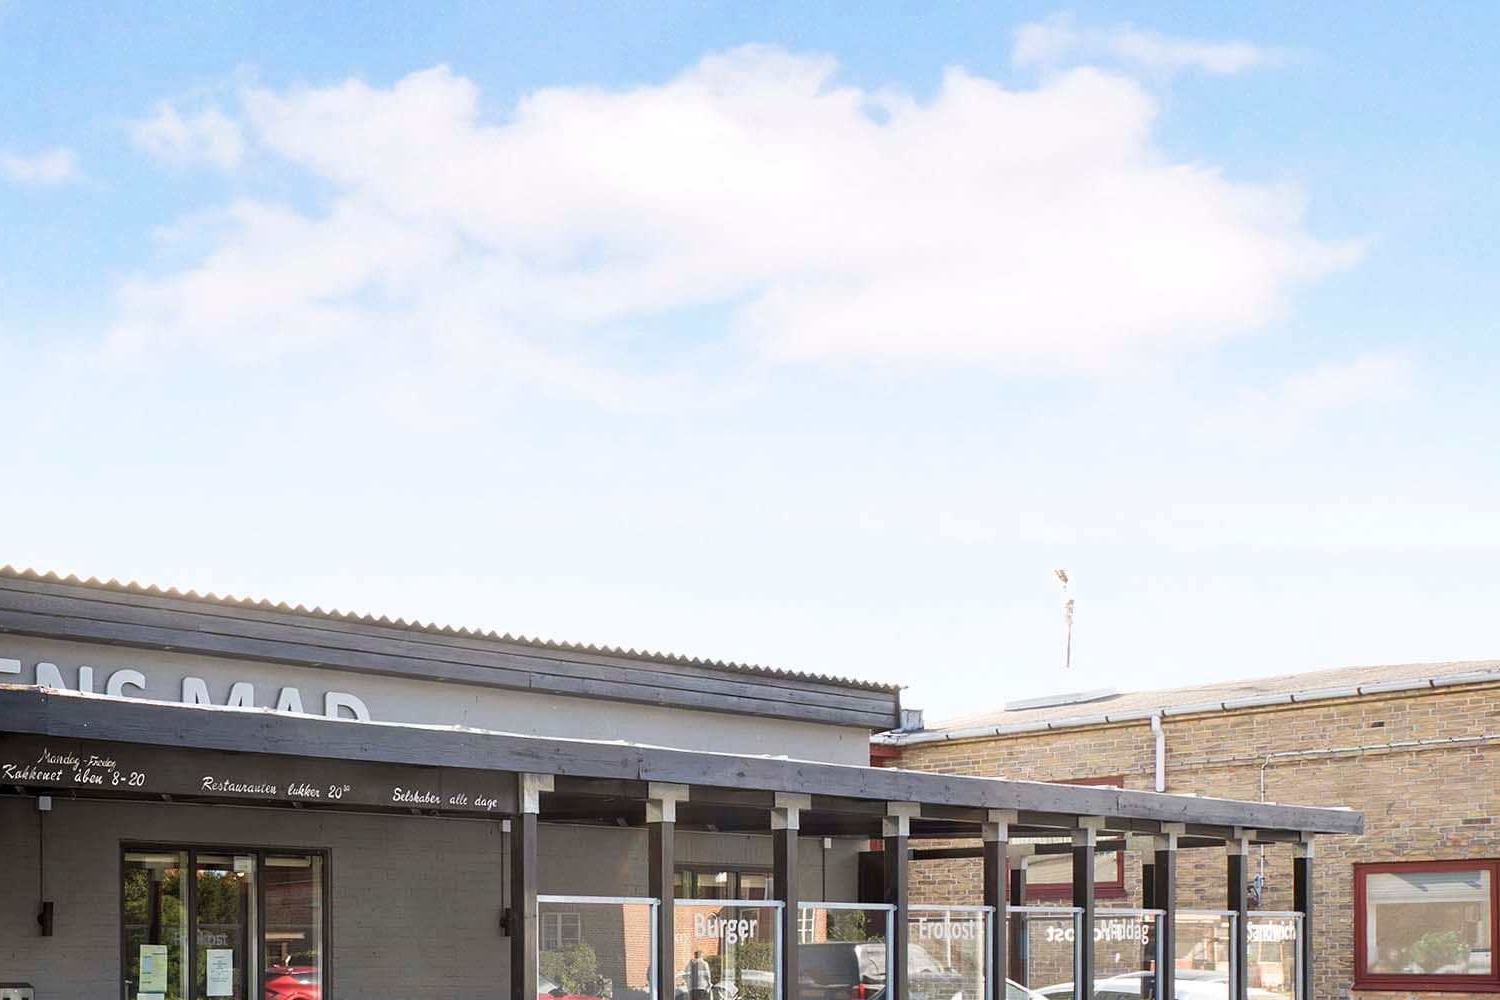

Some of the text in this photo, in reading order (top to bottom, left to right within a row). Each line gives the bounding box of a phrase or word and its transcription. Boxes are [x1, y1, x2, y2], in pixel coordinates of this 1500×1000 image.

[74, 767, 103, 785] åben
[111, 770, 145, 786] 8-20
[201, 776, 277, 795] Restauranten
[287, 783, 320, 798] lukker
[392, 787, 498, 811] Selskaber alle dage
[693, 911, 758, 944] Burger
[1247, 920, 1296, 943] Sandwich
